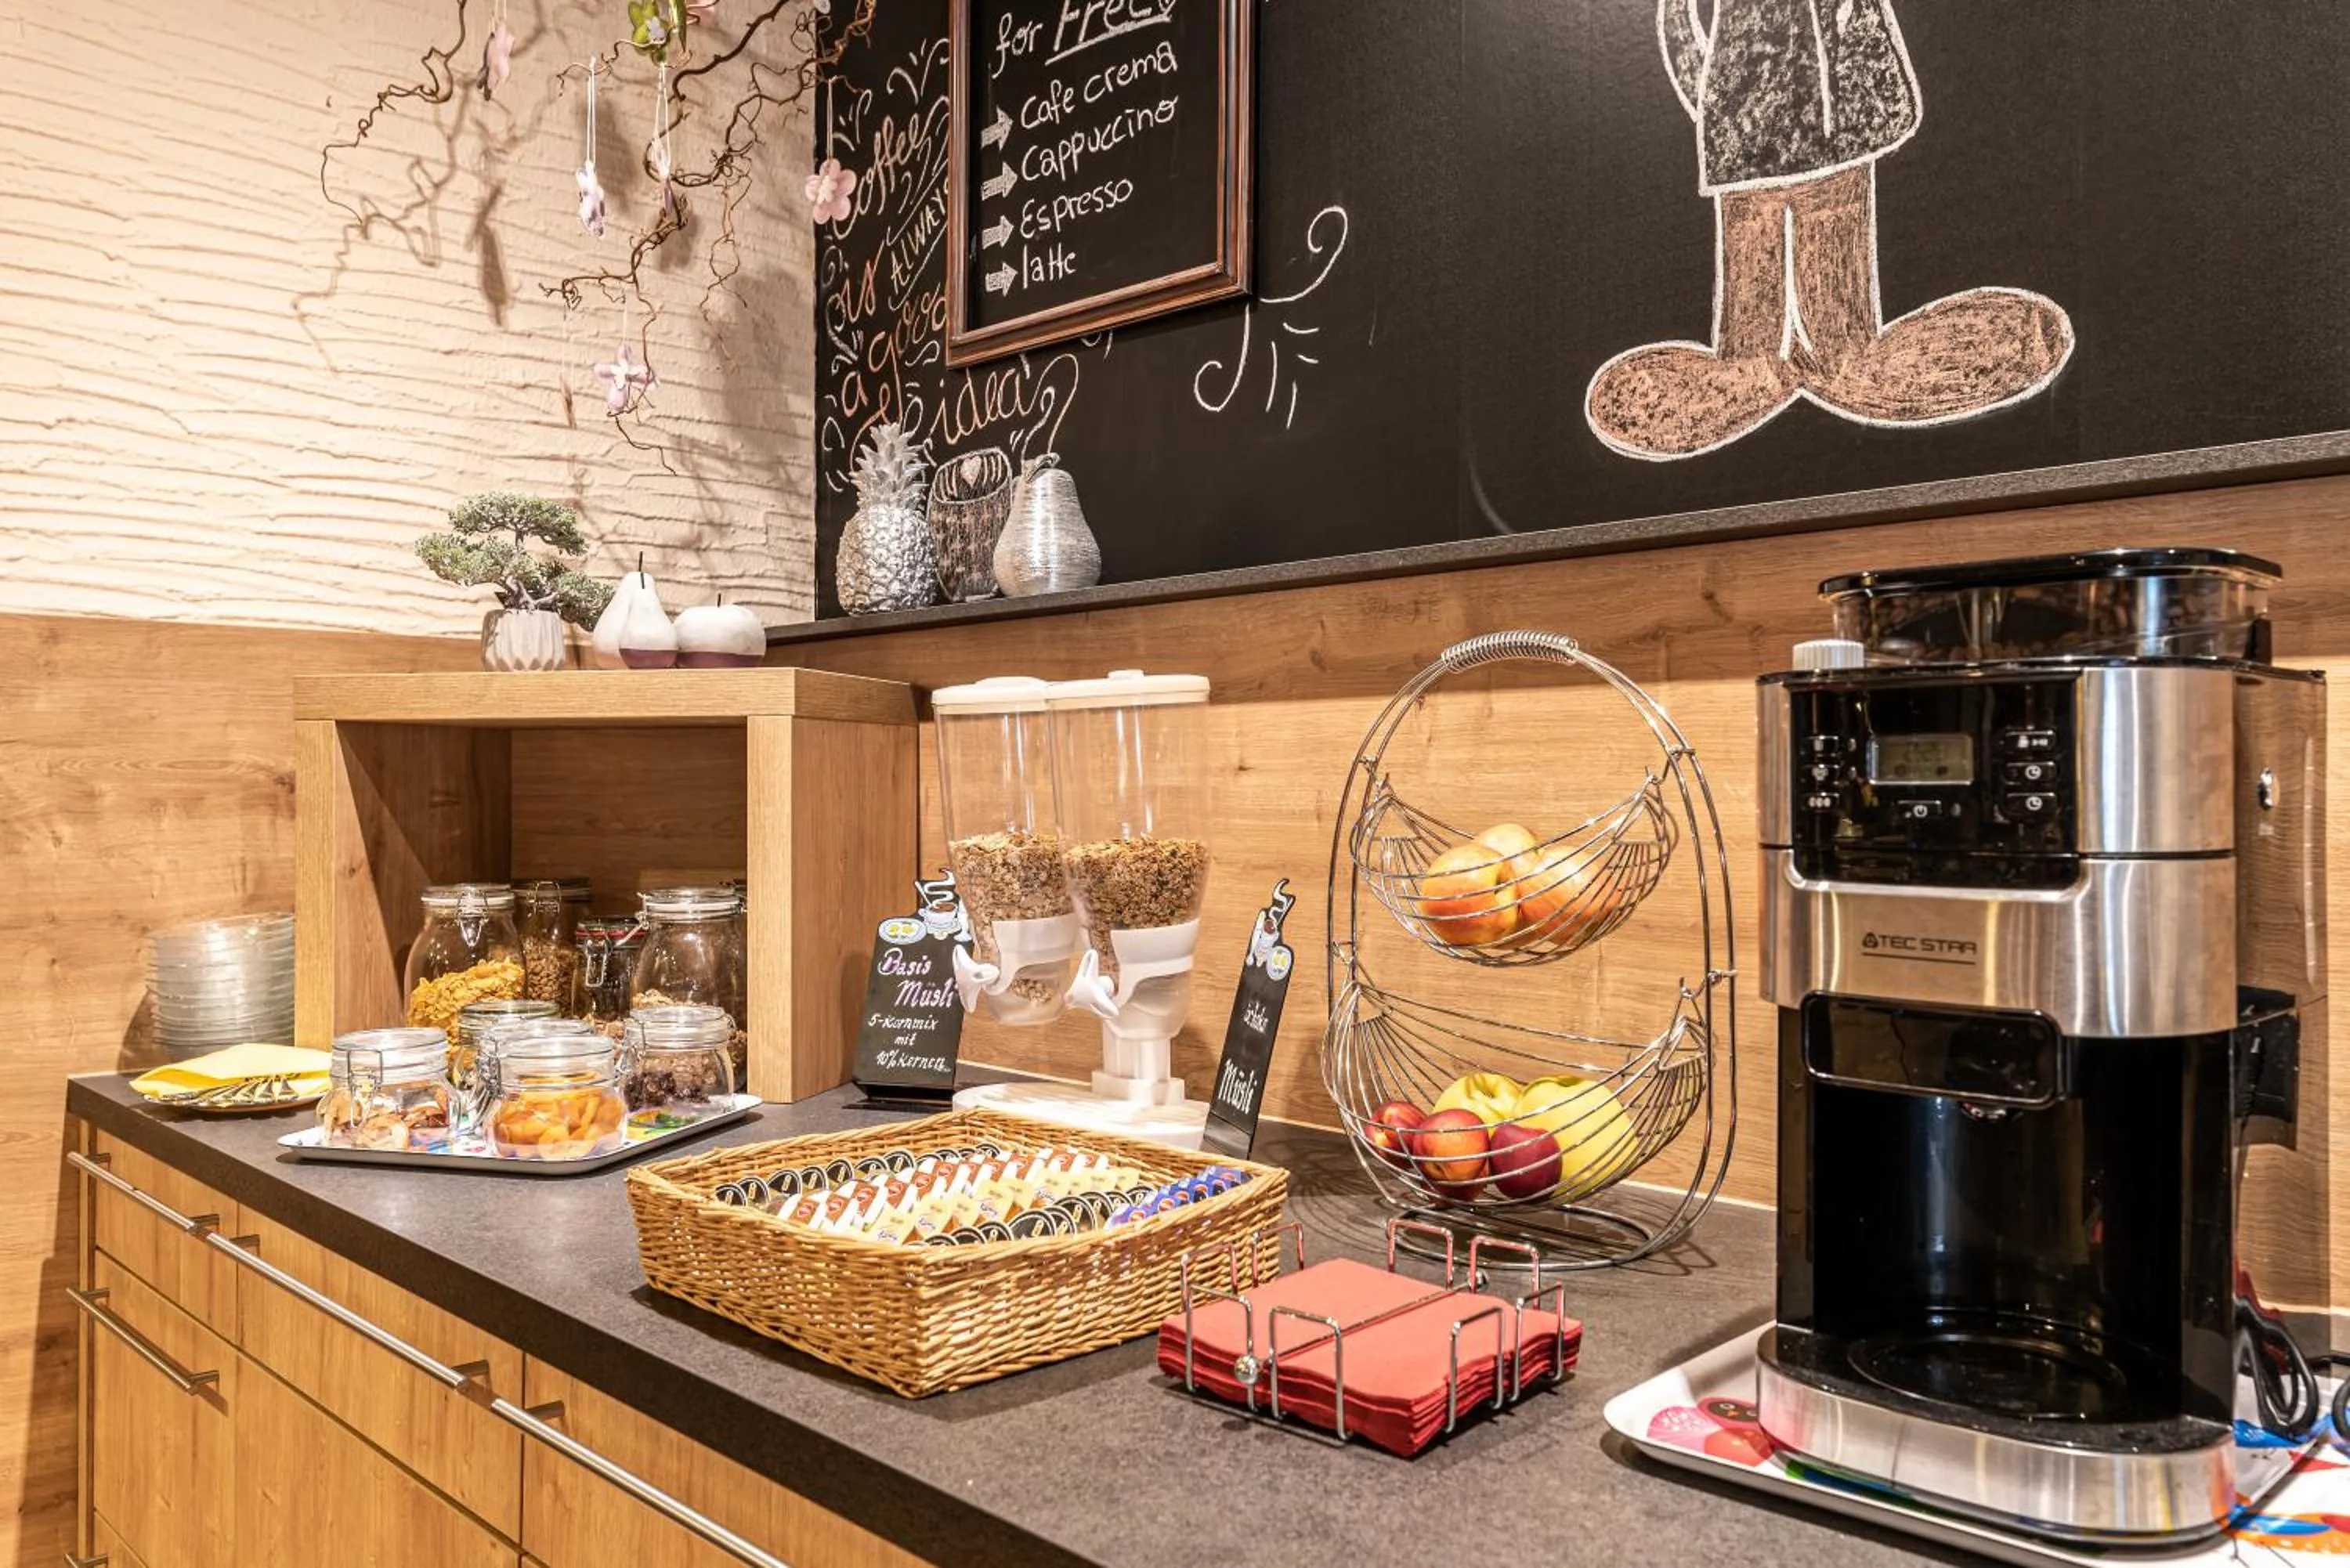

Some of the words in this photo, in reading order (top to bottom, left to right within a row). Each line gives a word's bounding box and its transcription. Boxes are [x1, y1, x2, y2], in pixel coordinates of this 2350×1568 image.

[992, 13, 1043, 78] for
[1021, 79, 1076, 129] Cafe
[1083, 41, 1178, 103] crema
[1021, 95, 1179, 182] Cappuccino
[1020, 178, 1133, 239] Espresso
[878, 947, 932, 976] Basis
[895, 977, 957, 1009] Müsli
[894, 1032, 917, 1046] mit
